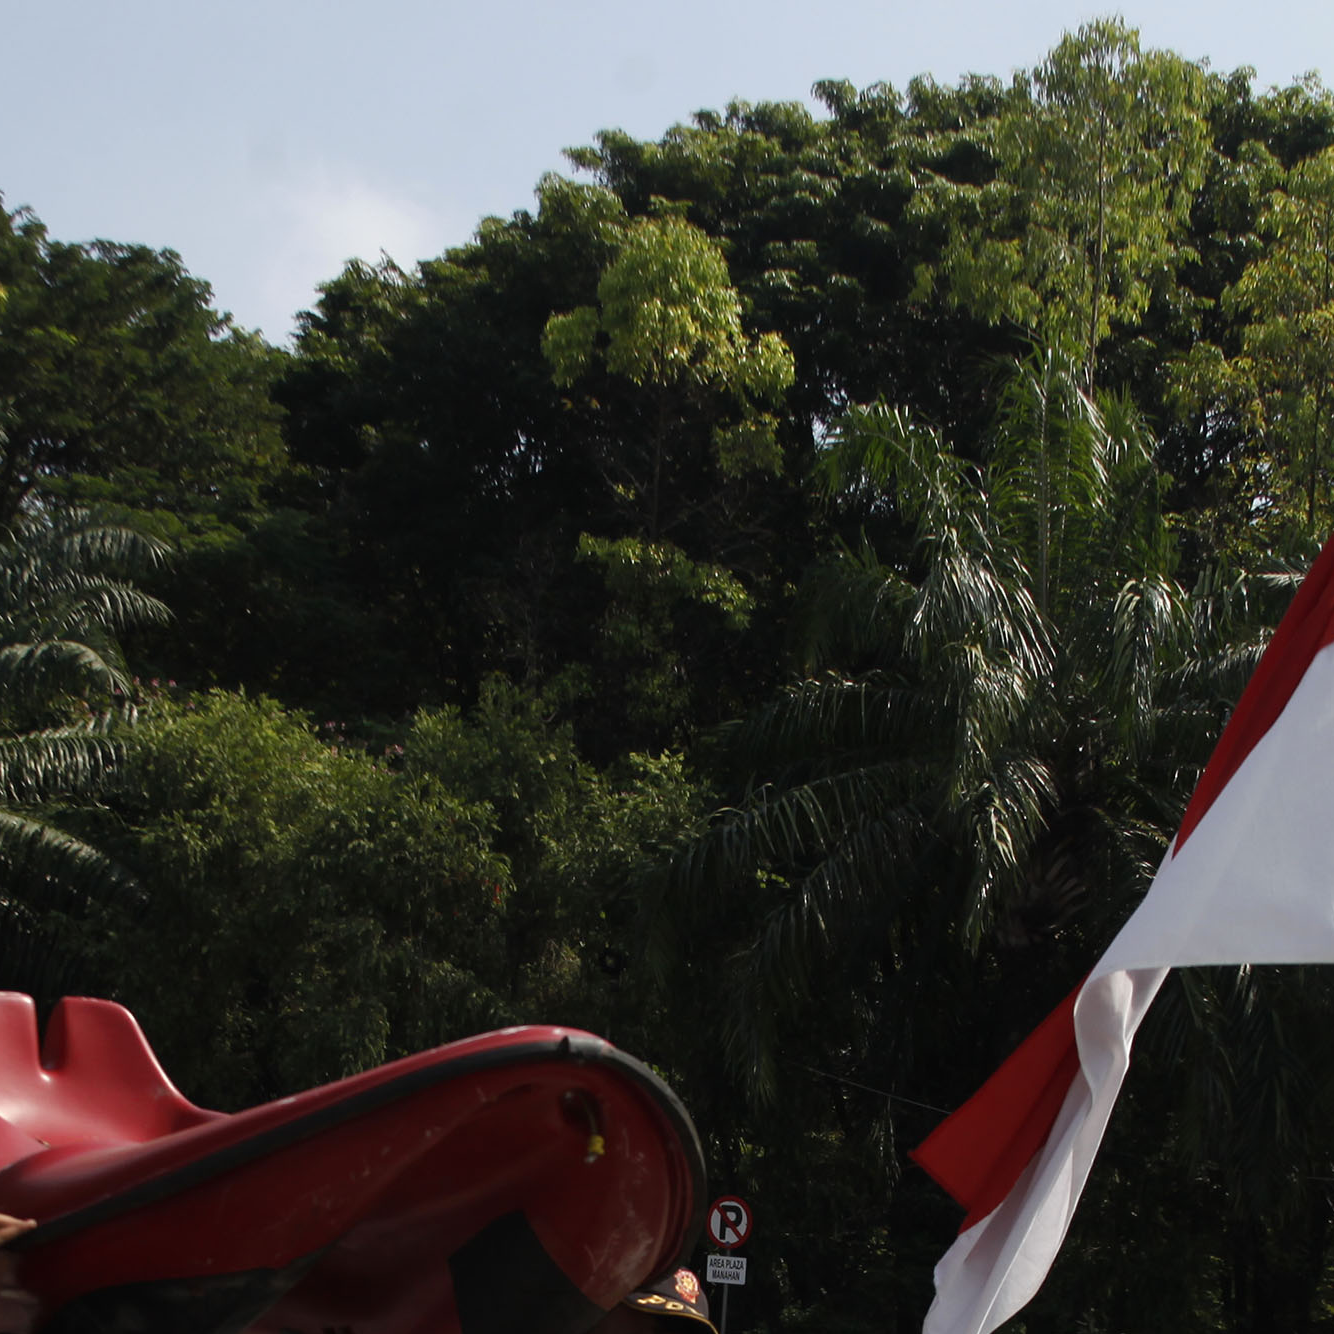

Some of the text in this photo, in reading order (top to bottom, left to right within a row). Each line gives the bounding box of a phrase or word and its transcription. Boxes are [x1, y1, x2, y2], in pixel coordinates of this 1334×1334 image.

[709, 1258, 745, 1270] AREA PLAZA
[712, 1269, 741, 1281] MANAHAN
